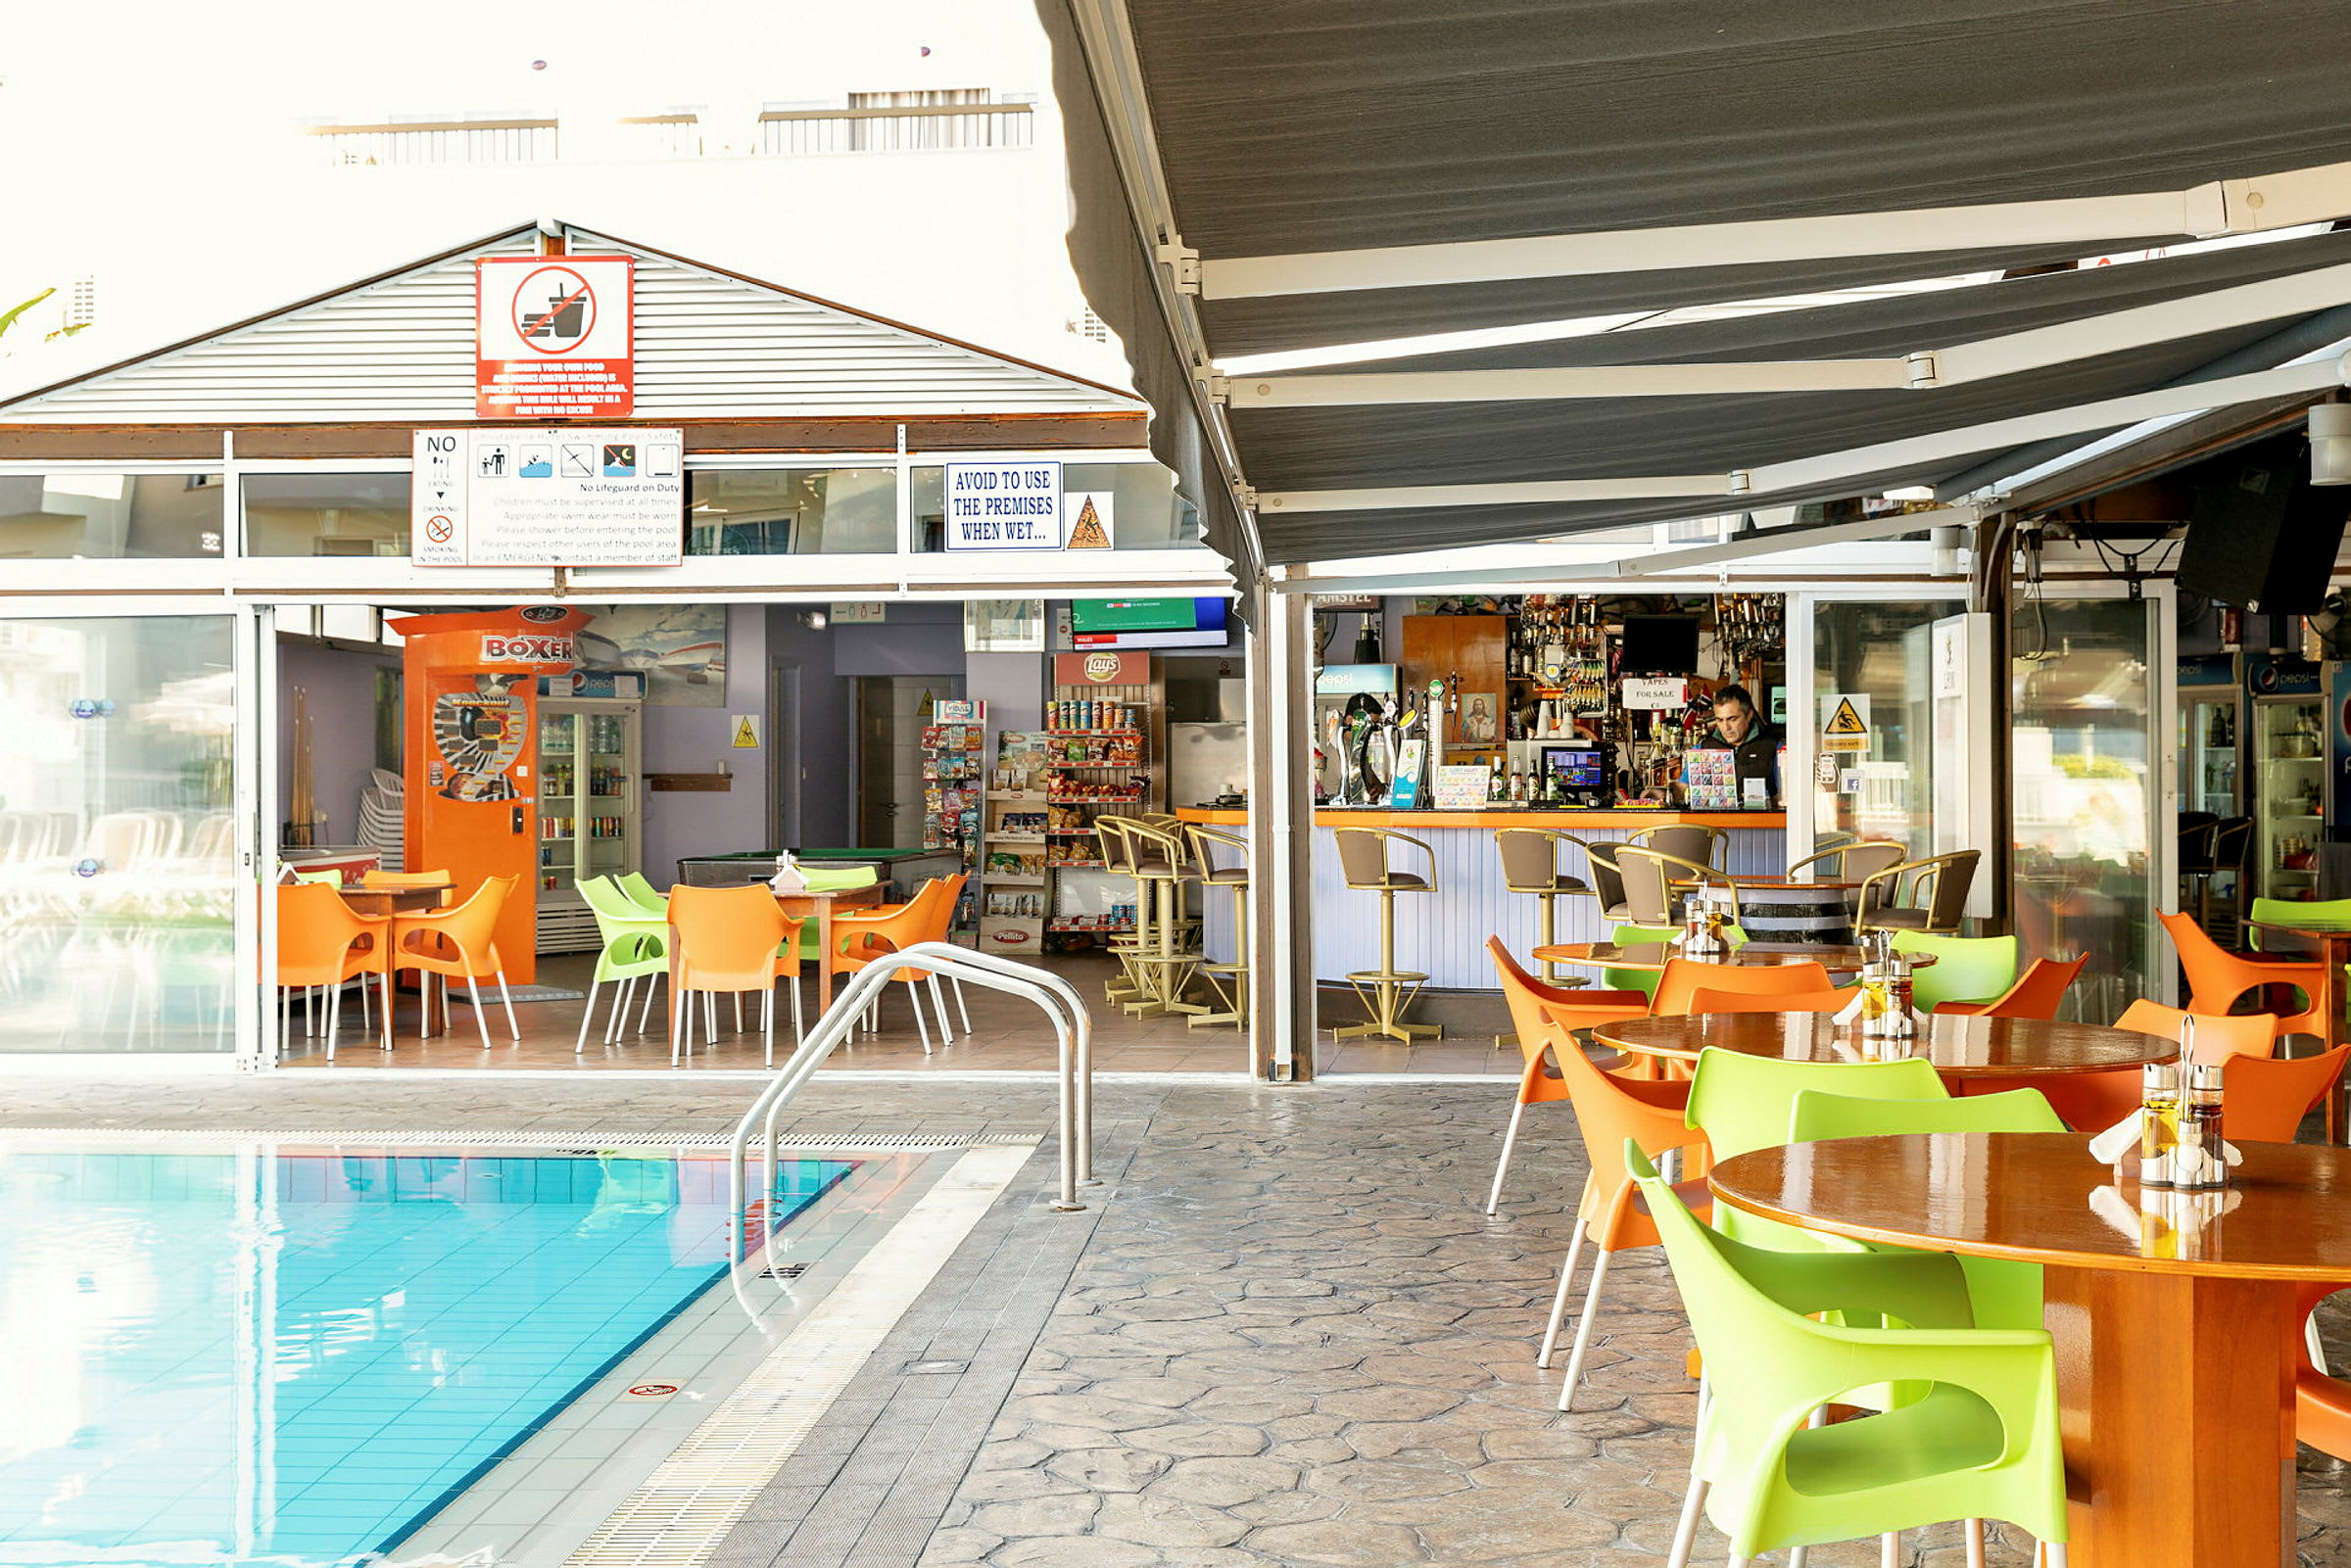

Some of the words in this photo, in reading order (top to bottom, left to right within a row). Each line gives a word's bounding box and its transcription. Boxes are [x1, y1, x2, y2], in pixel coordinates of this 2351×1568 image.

[427, 436, 456, 452] NO
[956, 472, 997, 490] AVOID
[1002, 471, 1020, 489] TO
[1025, 470, 1050, 489] USE
[596, 483, 640, 494] Lifeguard
[657, 484, 680, 494] Duty
[560, 498, 571, 506] be
[574, 498, 624, 508] supervised
[638, 498, 648, 506] all
[651, 498, 677, 506] times
[954, 498, 981, 516] THE
[985, 497, 1053, 515] PREMISES
[504, 511, 558, 521] Appropriate
[639, 511, 650, 520] be
[497, 525, 525, 534] Please
[529, 525, 561, 534] shower
[564, 525, 595, 534] before
[597, 526, 636, 536] entering
[639, 525, 653, 534] the
[656, 525, 677, 536] pool
[961, 522, 1000, 540] WHEN
[1005, 521, 1046, 540] WET...
[481, 540, 509, 548] Please
[512, 541, 547, 550] respect
[549, 540, 573, 548] other
[615, 540, 630, 548] the
[633, 540, 653, 550] pool
[603, 553, 643, 562] member
[657, 553, 678, 562] staff
[484, 638, 573, 661] BOXER
[590, 678, 614, 689] peps
[2279, 672, 2309, 685] pepsi
